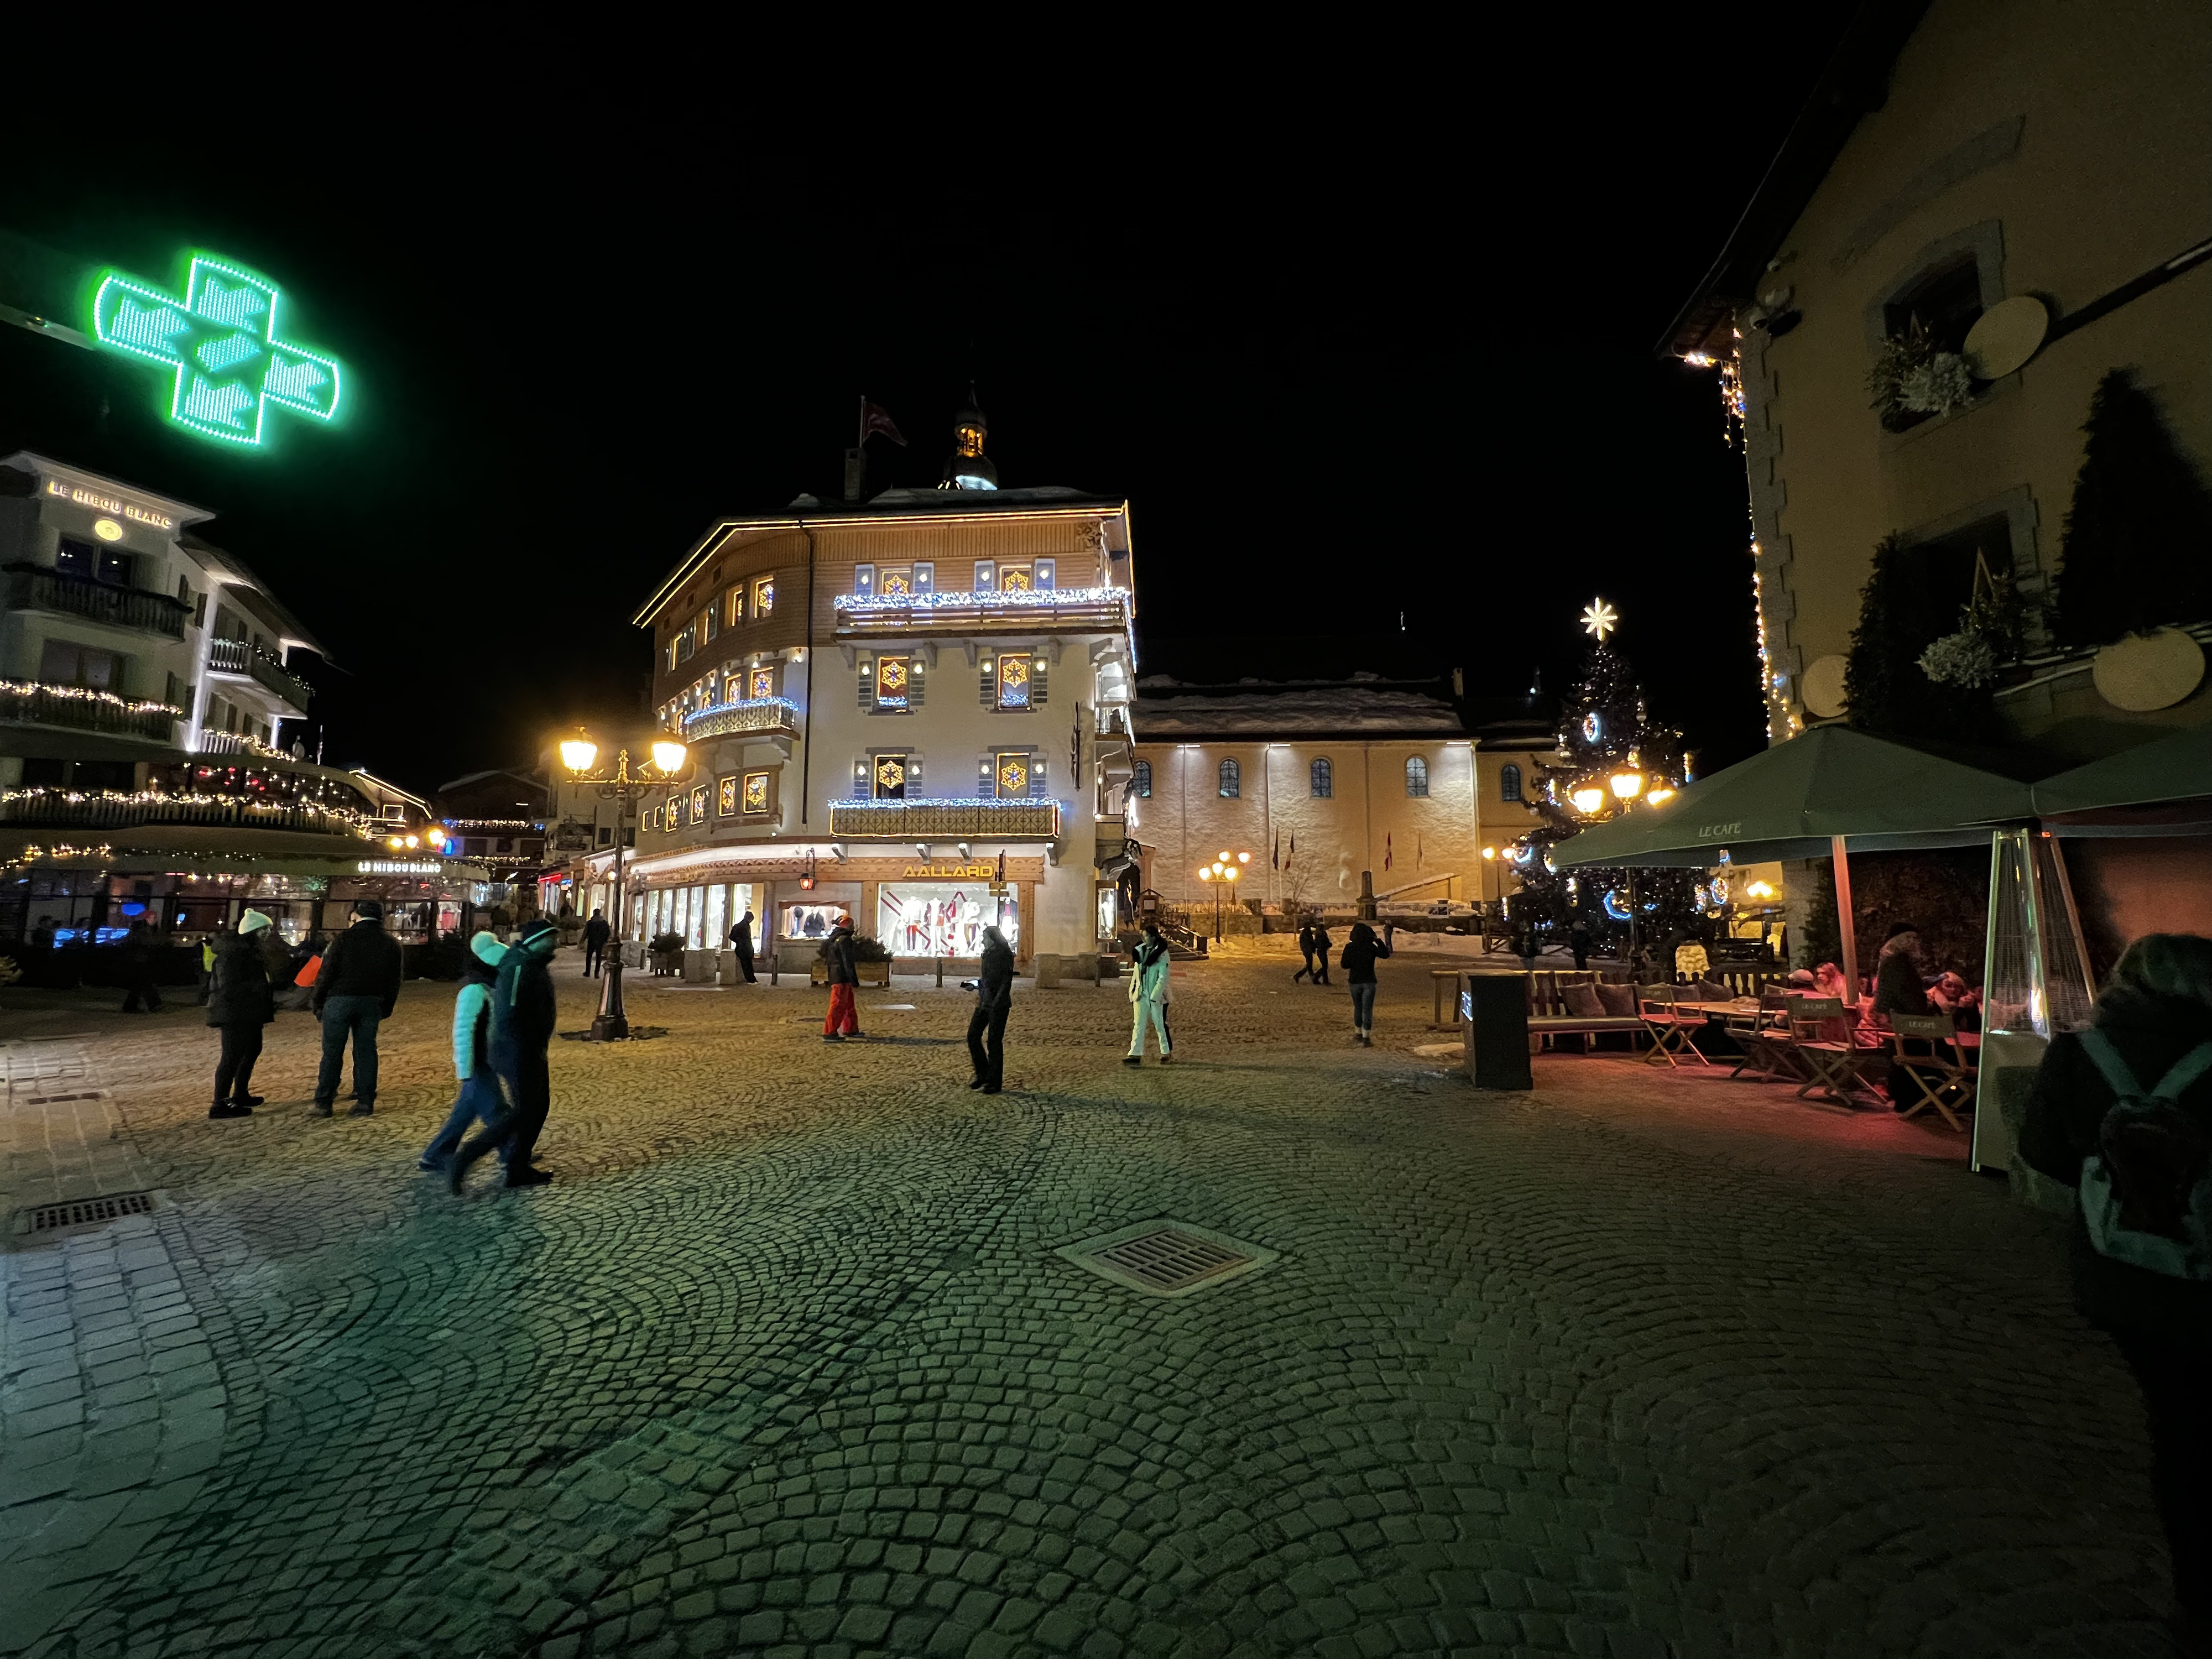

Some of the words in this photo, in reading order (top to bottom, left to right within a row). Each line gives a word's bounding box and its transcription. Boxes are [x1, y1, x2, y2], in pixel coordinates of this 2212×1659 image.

[48, 481, 69, 497] LE
[72, 489, 122, 514] HIBOU
[124, 505, 172, 529] BLANC
[1699, 826, 1712, 837] LE
[358, 862, 371, 872] LE
[373, 862, 409, 872] HIBOU
[409, 862, 441, 873] BLANC
[902, 865, 994, 878] AALLARD
